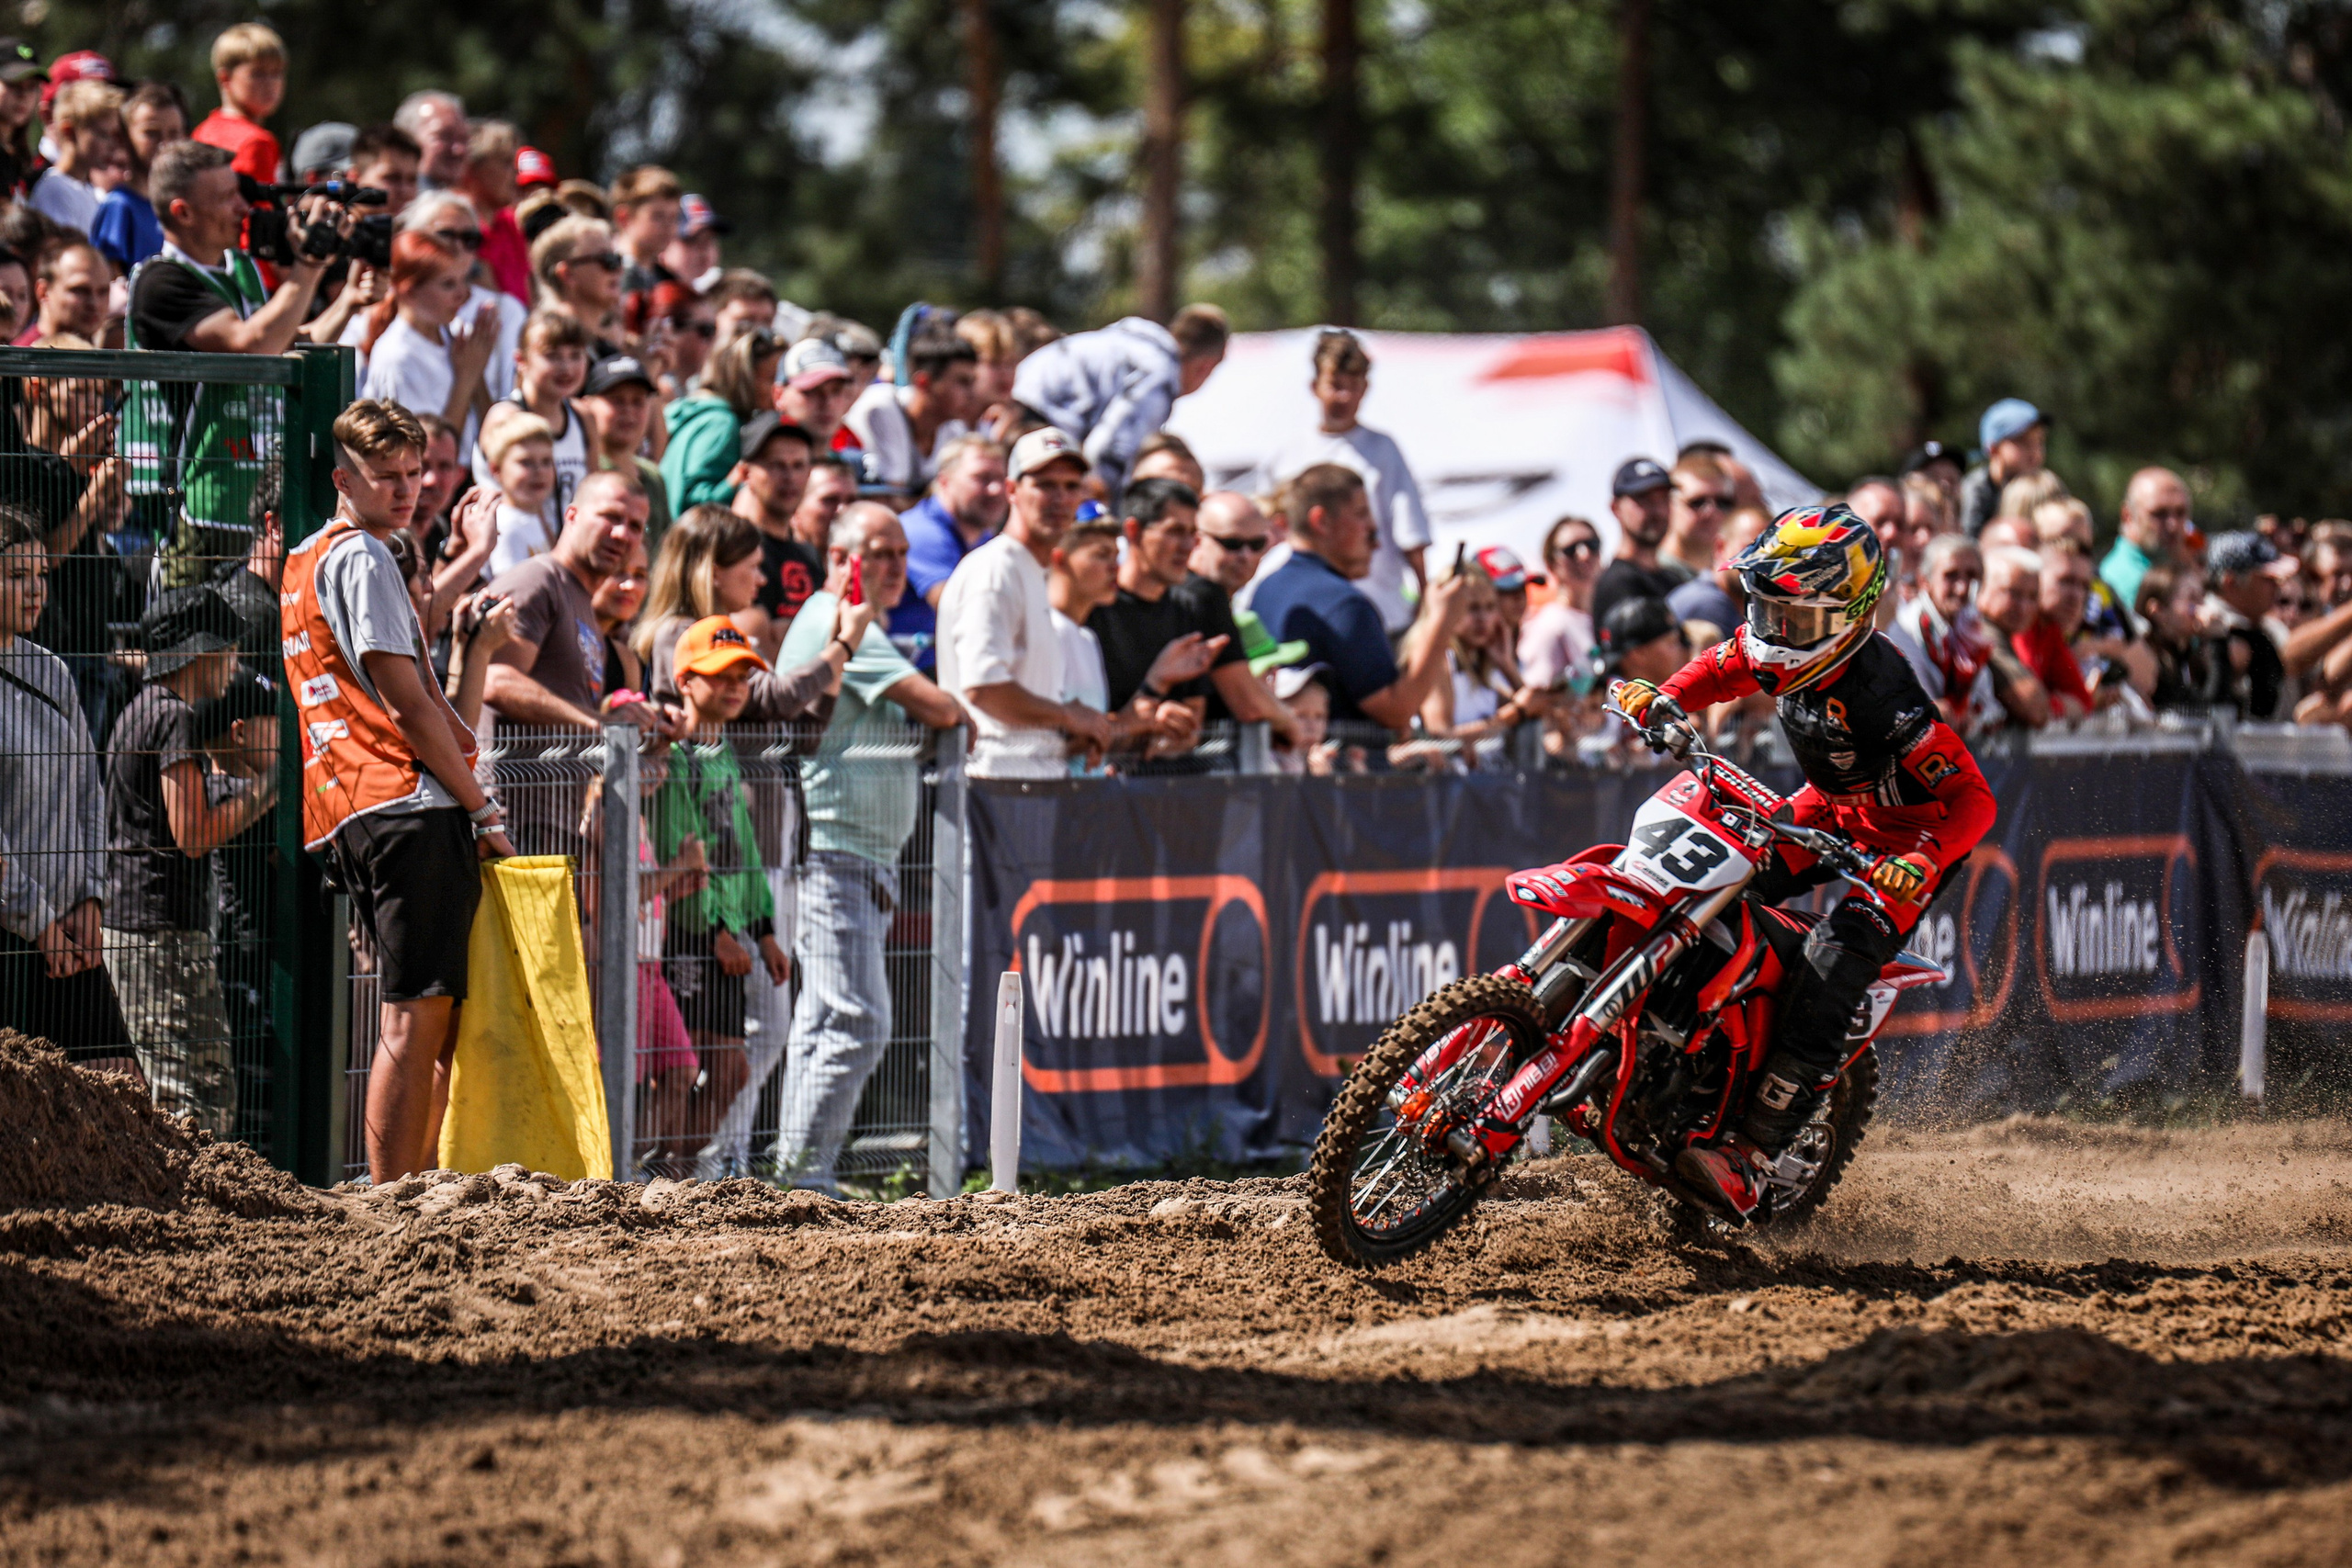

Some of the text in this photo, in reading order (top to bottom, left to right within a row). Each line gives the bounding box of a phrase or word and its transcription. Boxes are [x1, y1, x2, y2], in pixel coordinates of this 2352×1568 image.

[1634, 817, 1730, 885] 43
[2047, 878, 2159, 976] Winline
[1027, 930, 1188, 1039] Winline
